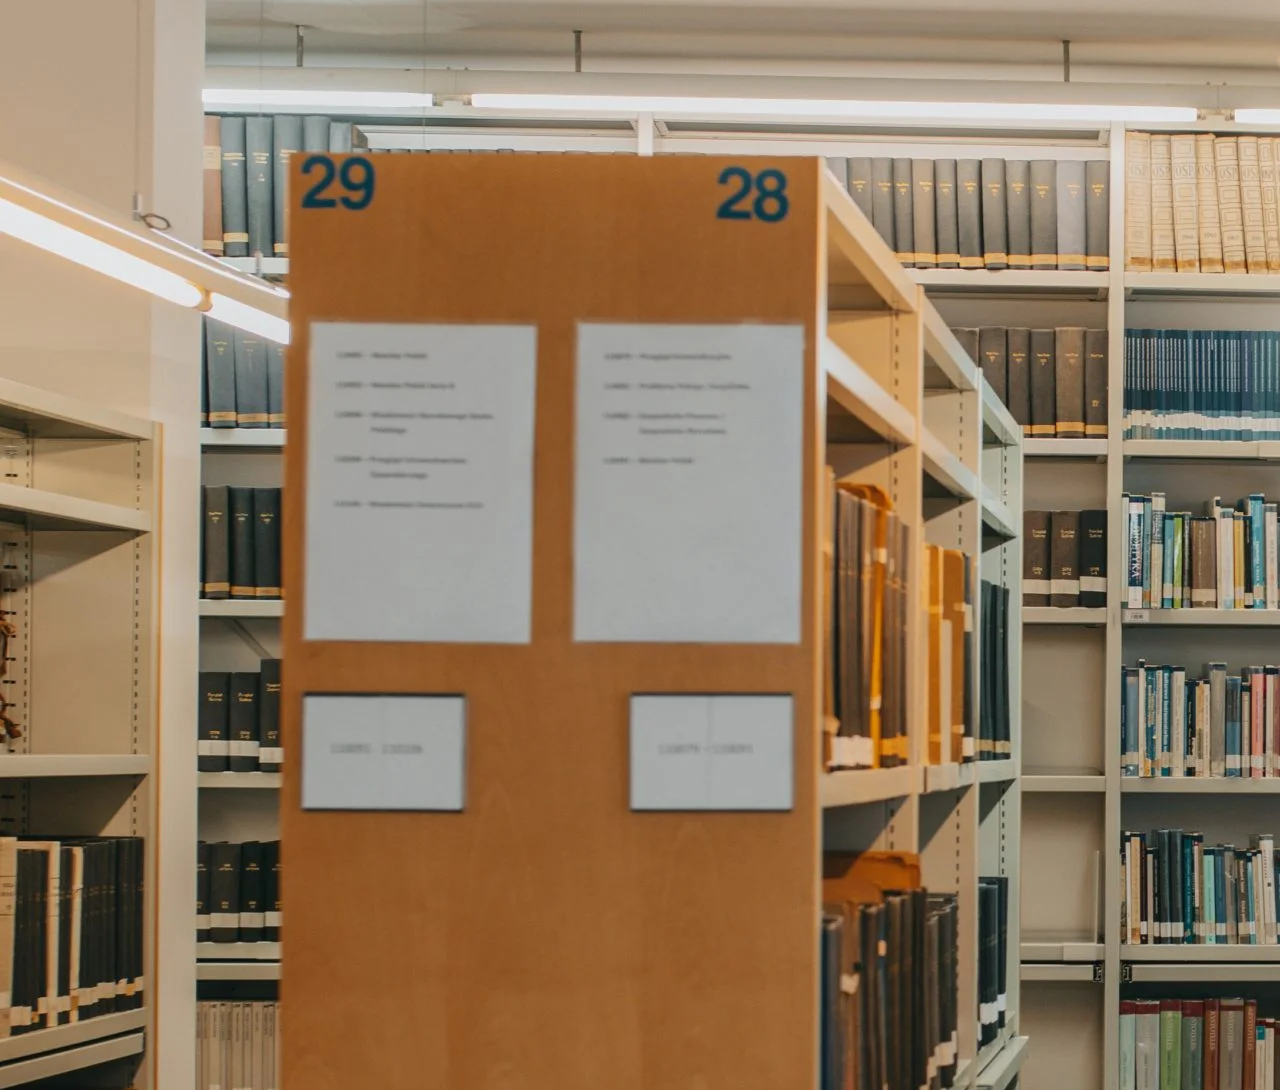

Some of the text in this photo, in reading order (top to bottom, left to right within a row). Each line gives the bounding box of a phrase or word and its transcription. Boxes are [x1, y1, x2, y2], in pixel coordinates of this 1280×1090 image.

[301, 155, 375, 210] 29
[716, 167, 789, 222] 28
[1175, 163, 1195, 177] OSP
